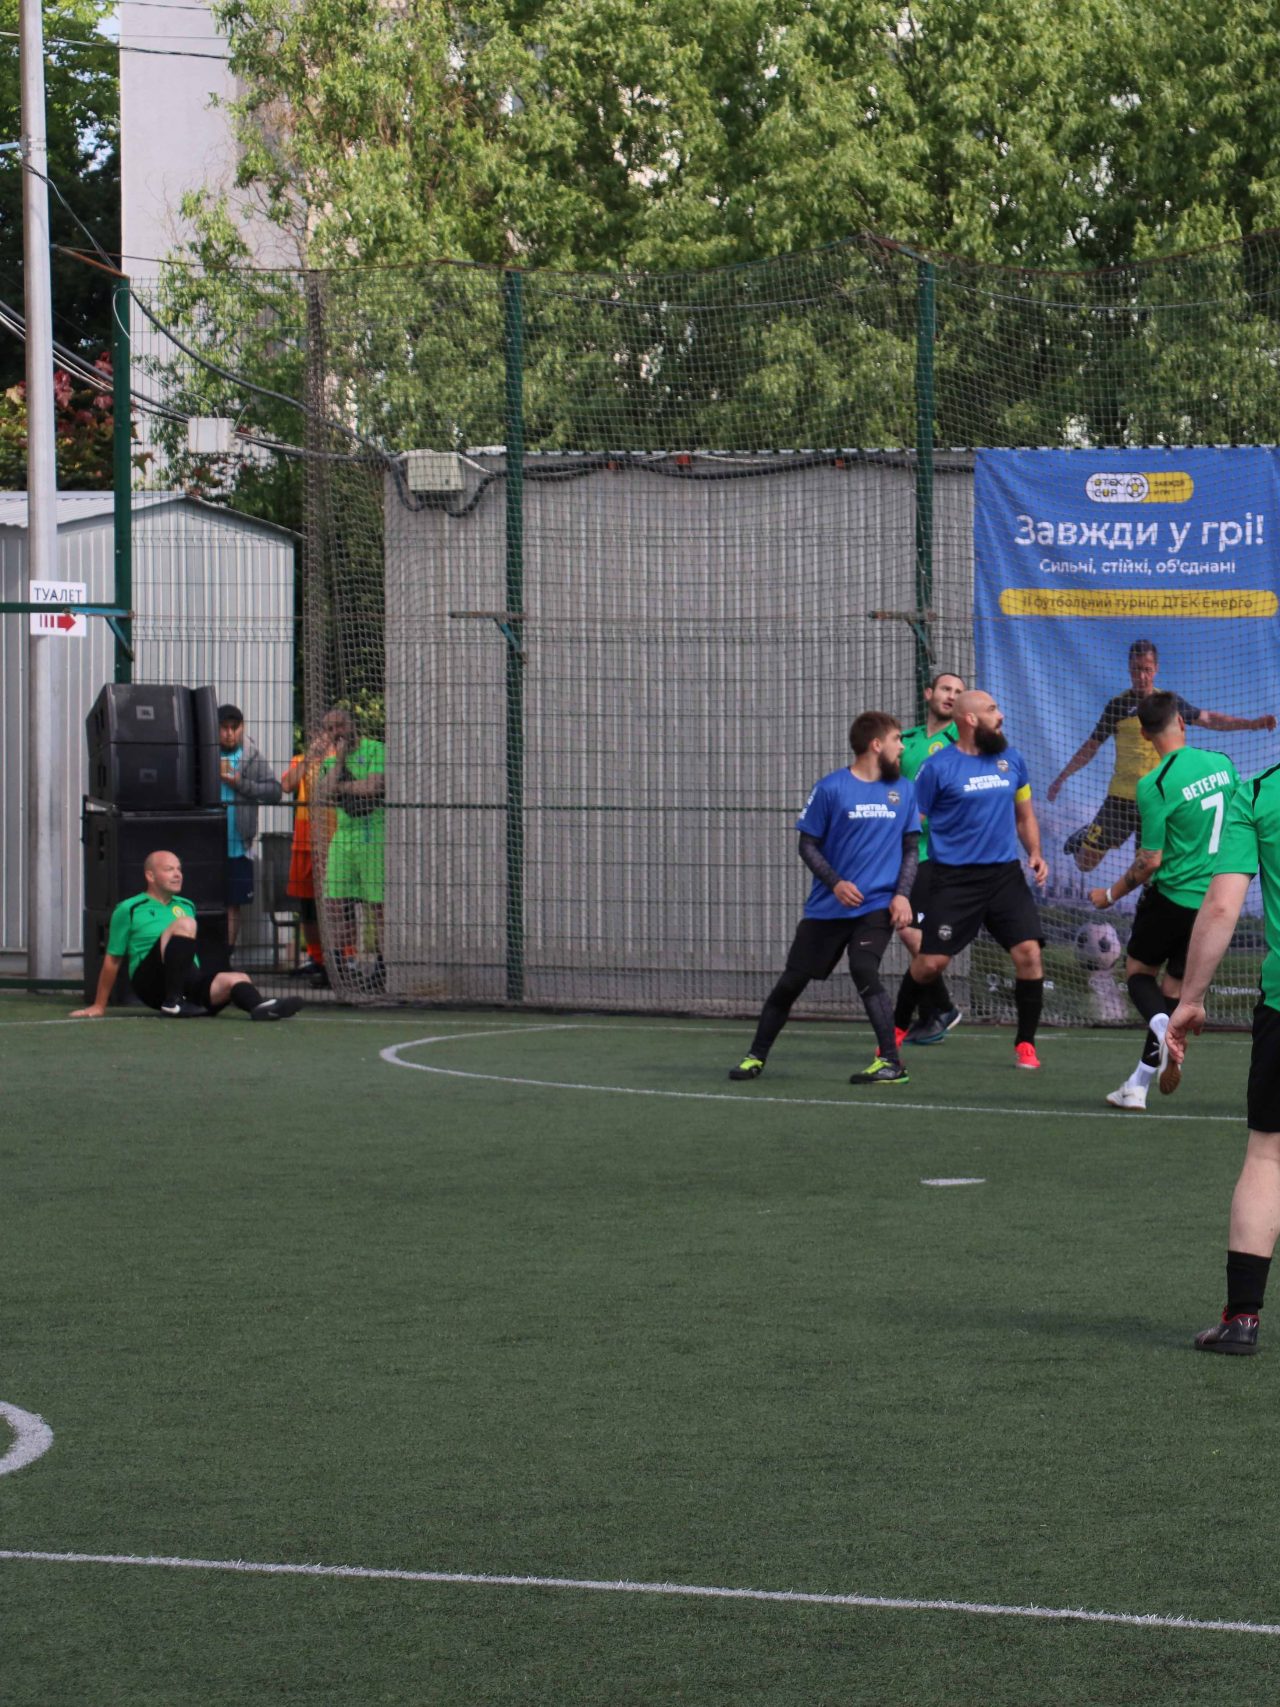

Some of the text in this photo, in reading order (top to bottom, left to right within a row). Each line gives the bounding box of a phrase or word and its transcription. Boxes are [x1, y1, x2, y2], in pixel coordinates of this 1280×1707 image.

[1014, 512, 1264, 553] Завжди у грі!
[1039, 557, 1097, 575] Сильні,
[1101, 557, 1152, 575] стійкі,
[34, 587, 83, 602] ТУАЛЕТ
[1033, 595, 1112, 610] футбольний
[1115, 596, 1158, 610] турнір
[1162, 596, 1199, 610] ДТЕК
[1202, 596, 1253, 610] Енерго
[1182, 770, 1231, 801] ВЕТЕРАН
[1201, 791, 1224, 854] 7
